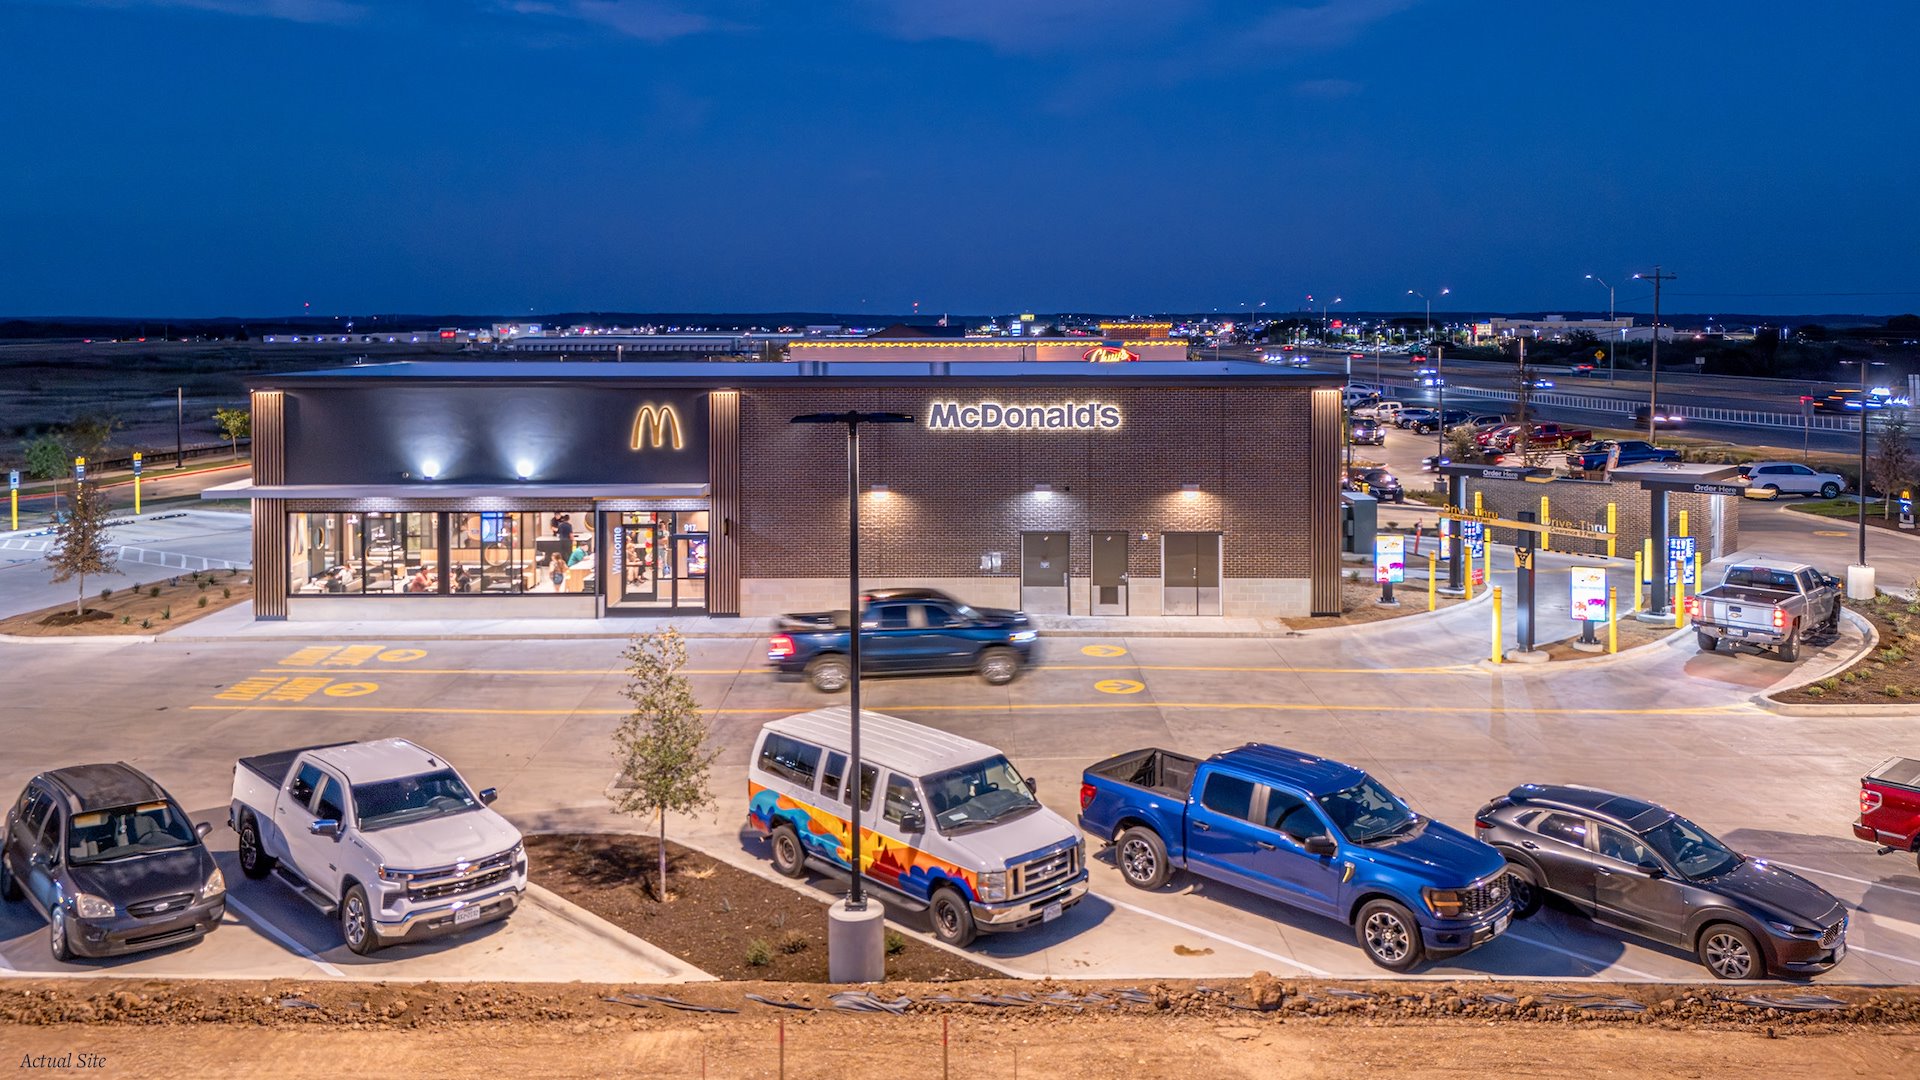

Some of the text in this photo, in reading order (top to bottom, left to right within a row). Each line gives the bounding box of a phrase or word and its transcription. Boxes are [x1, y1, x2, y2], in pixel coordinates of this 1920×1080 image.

[928, 402, 1121, 430] McDonald's
[1482, 469, 1518, 479] Order Here
[1694, 484, 1737, 494] Order Here
[1549, 527, 1578, 537] Clearance
[612, 527, 622, 574] Welcome
